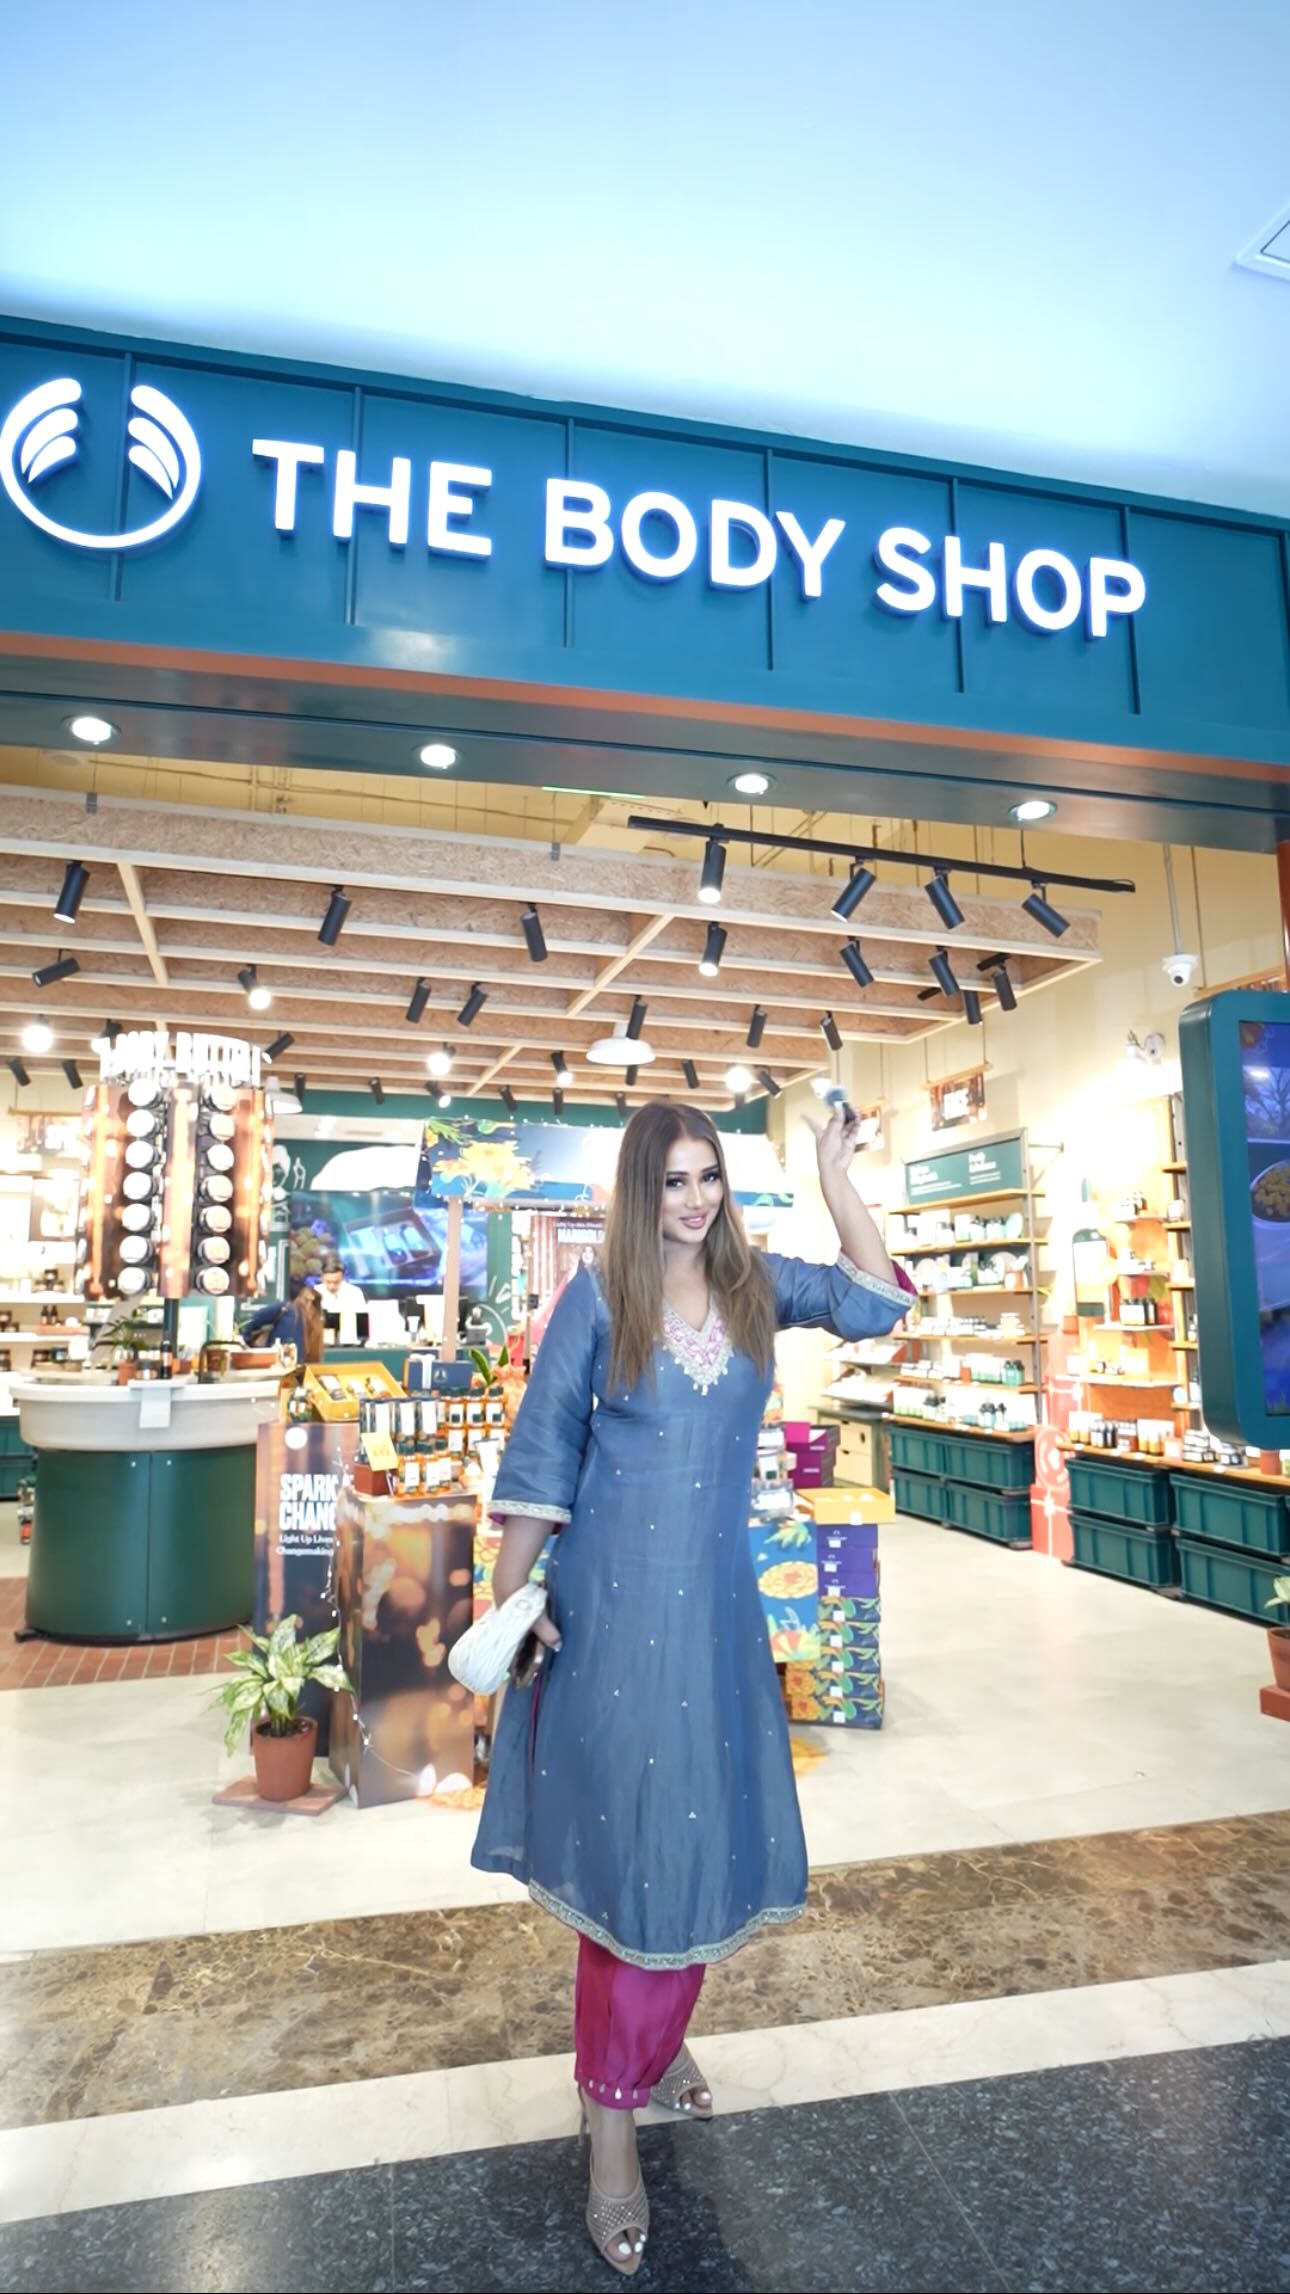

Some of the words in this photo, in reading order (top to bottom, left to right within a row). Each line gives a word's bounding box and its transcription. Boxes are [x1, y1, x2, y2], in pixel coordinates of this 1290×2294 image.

[252, 438, 493, 559] THE
[544, 476, 846, 600] BODY
[875, 525, 1147, 639] SHOP
[280, 1473, 339, 1501] SPARK
[279, 1501, 336, 1531] CHANG
